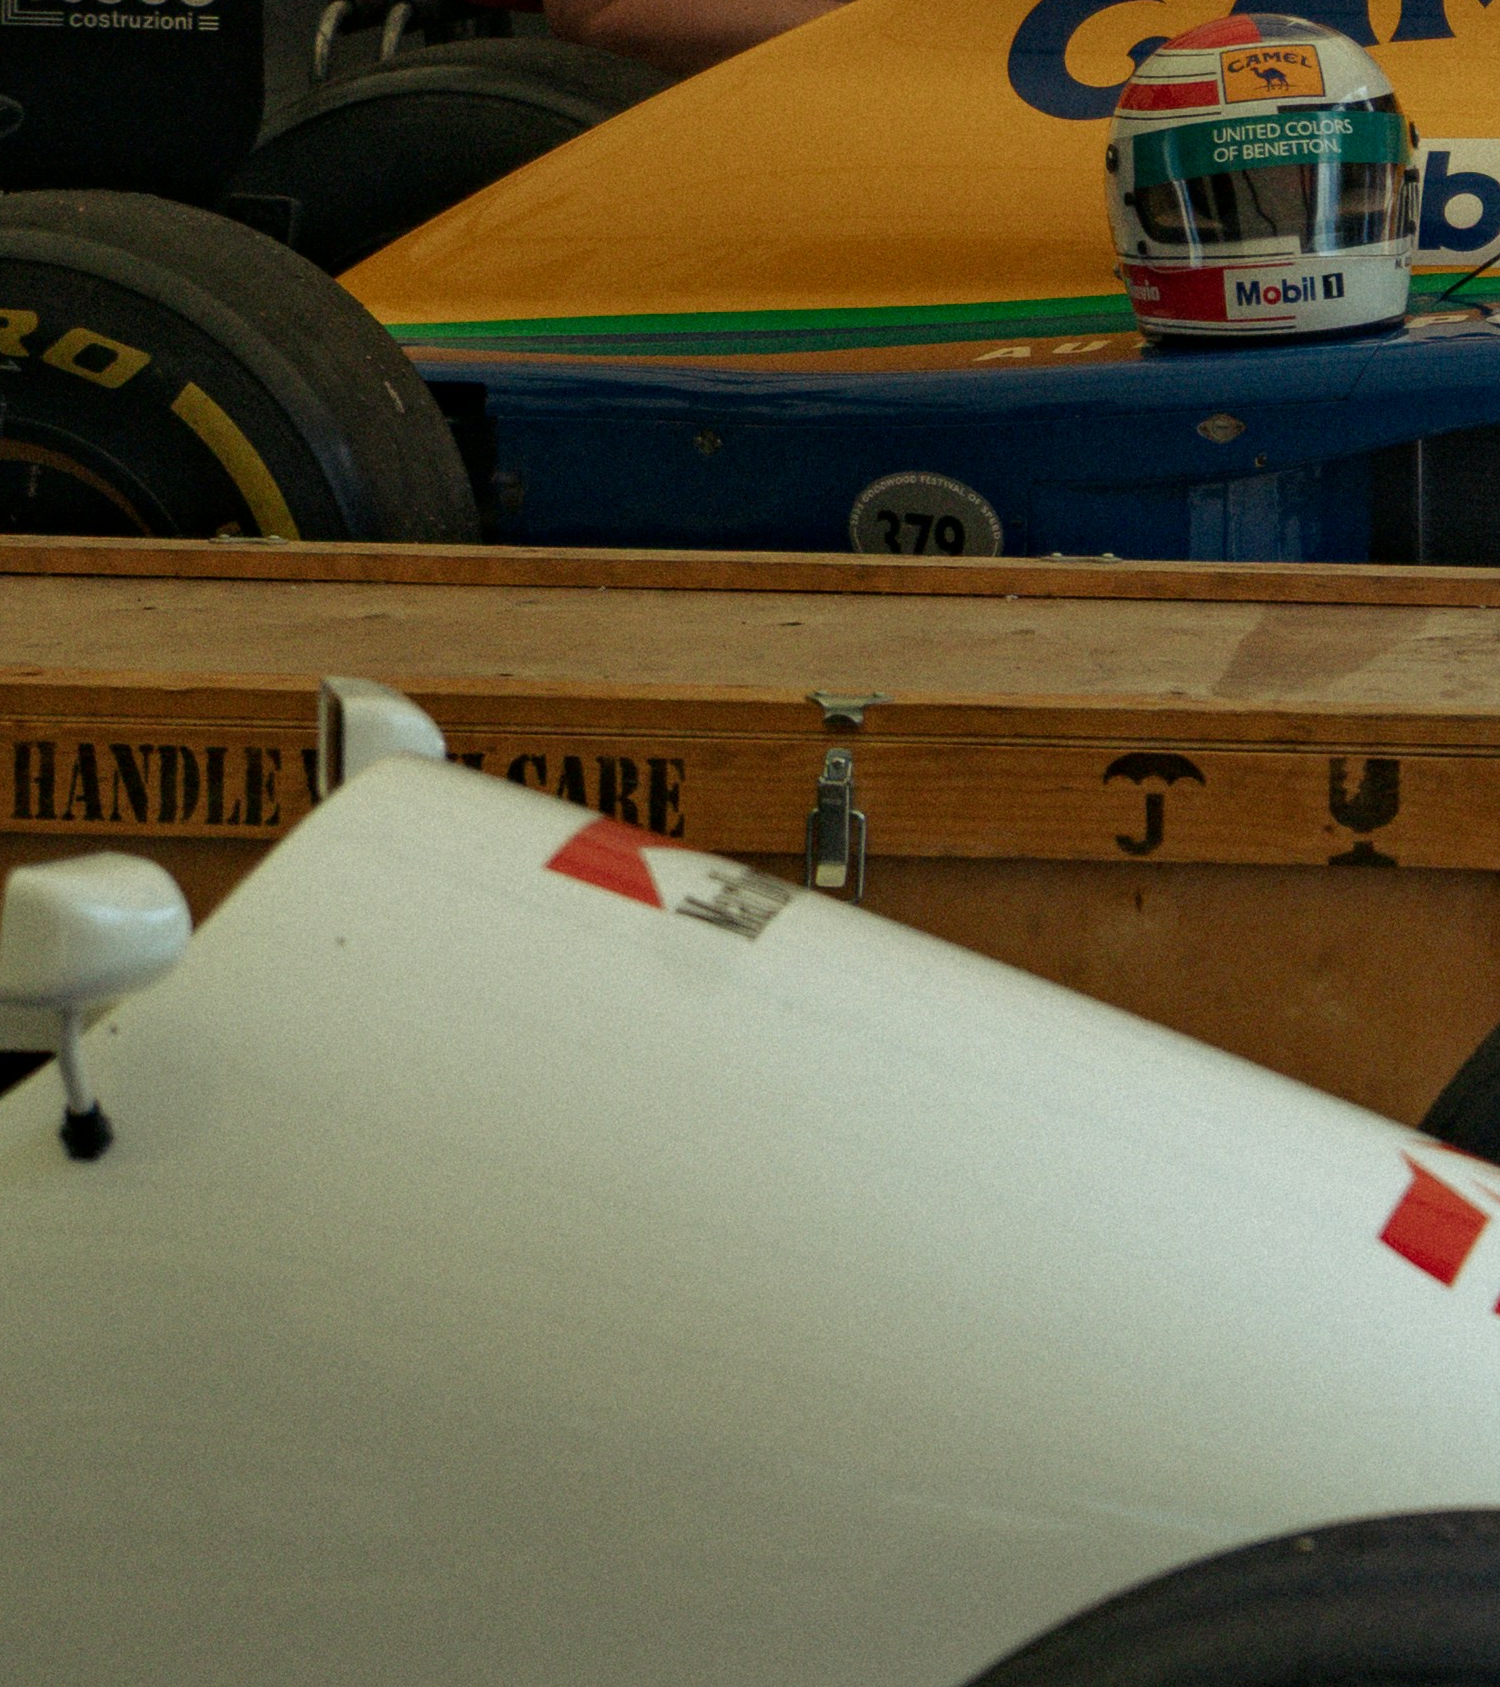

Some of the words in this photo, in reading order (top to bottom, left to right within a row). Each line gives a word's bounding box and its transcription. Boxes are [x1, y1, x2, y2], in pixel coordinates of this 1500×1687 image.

[69, 10, 193, 32] costruzioni
[1226, 50, 1313, 73] CAMEL
[1213, 122, 1281, 145] UNITED
[1284, 118, 1354, 139] COLORS
[1213, 146, 1239, 163] OF
[1242, 138, 1343, 160] BENETTON.
[1235, 275, 1317, 307] Mobil
[1325, 273, 1344, 299] 1
[861, 474, 918, 504] GOODWOOD
[919, 475, 966, 497] FESTIVAL
[10, 741, 281, 828] HANDLE
[507, 752, 686, 838] CARE
